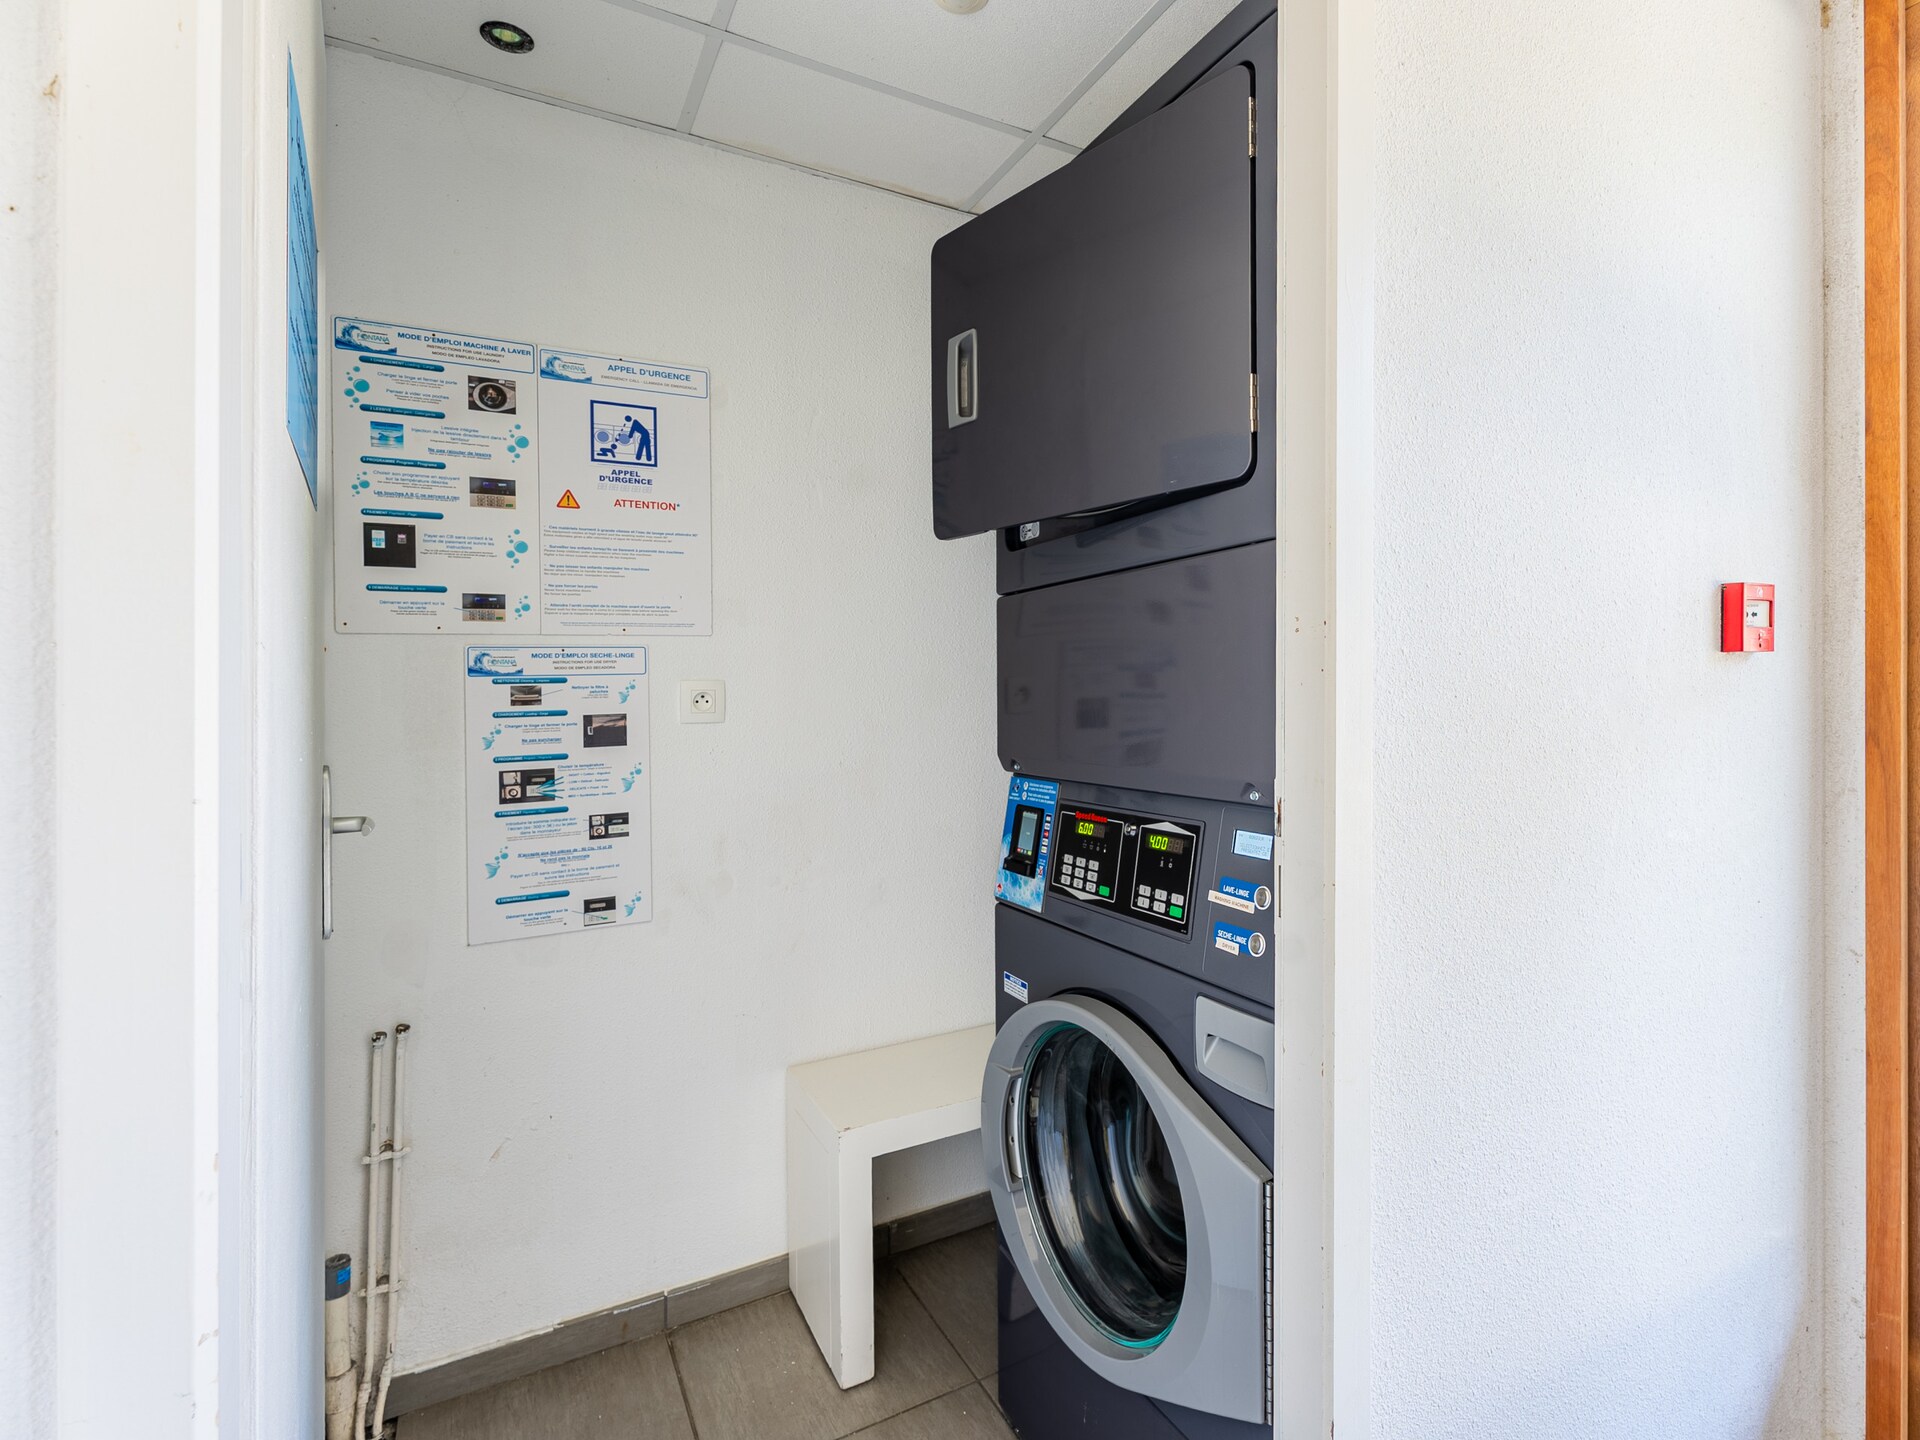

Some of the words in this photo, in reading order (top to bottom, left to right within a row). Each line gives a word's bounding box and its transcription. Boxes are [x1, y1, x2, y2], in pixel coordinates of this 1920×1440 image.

[397, 331, 420, 341] MODE
[422, 335, 462, 347] D'EMPLOI
[464, 341, 497, 352] MACHINE
[506, 347, 531, 356] LAVER
[607, 364, 638, 375] APPEL
[640, 368, 691, 381] D'URGENCE
[599, 475, 652, 485] D'URGENCE
[611, 469, 640, 477] APPEL
[1150, 835, 1168, 850] 4.00
[1222, 884, 1250, 899] LAVE-LINGE
